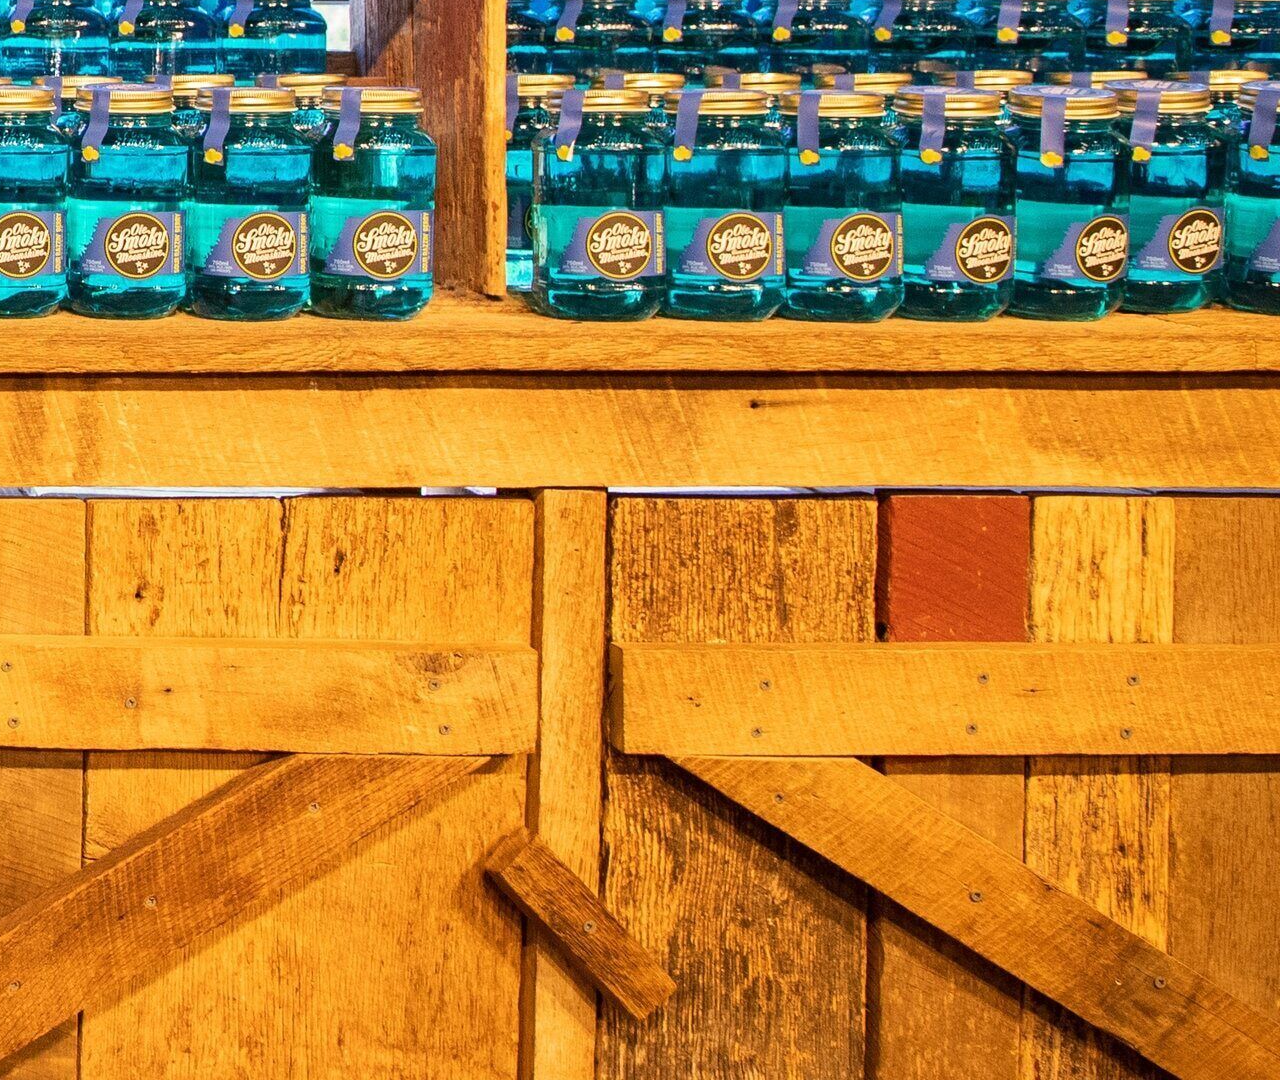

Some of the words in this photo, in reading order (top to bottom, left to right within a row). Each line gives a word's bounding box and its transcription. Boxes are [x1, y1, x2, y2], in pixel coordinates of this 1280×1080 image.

[12, 223, 32, 236] Ole
[129, 224, 151, 237] Ole
[258, 224, 278, 237] Ole
[379, 223, 399, 236] Ole
[612, 223, 634, 236] Ole
[732, 224, 754, 237] Ole
[856, 225, 876, 238] Ole
[108, 227, 168, 253] Smoky
[237, 227, 295, 254] Smoky
[358, 226, 416, 253] Smoky
[591, 226, 651, 253] Smoky
[711, 227, 771, 254] Smoky
[835, 228, 893, 255] Smoky
[116, 250, 165, 264] Moonshine
[244, 250, 293, 265] Moonshine
[365, 249, 414, 264] Moonshine
[599, 249, 648, 264] Moonshine
[719, 250, 768, 265] Moonshine
[842, 251, 891, 266] Moonshine
